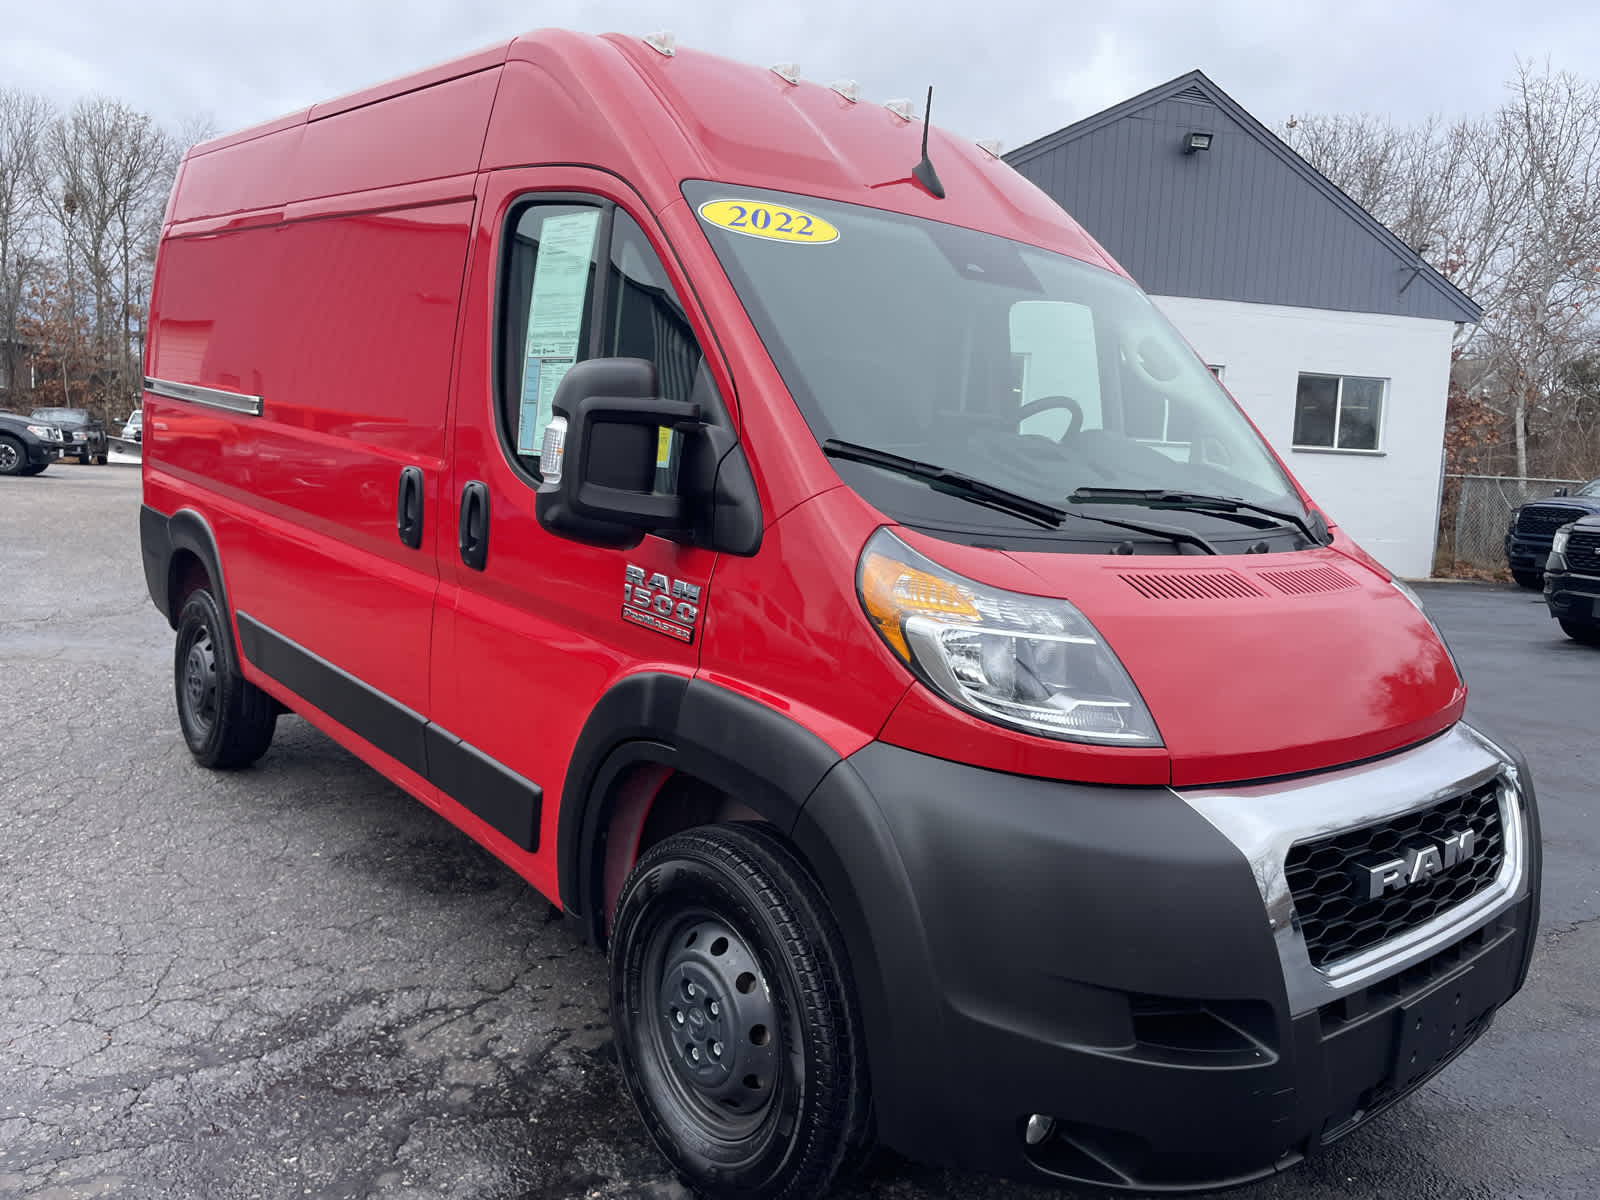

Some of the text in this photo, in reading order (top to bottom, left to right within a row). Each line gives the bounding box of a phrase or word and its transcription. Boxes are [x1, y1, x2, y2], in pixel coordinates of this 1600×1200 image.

[728, 206, 813, 236] 2022
[624, 584, 698, 624] 1500
[625, 564, 701, 604] RAM
[1370, 828, 1475, 899] RAM
